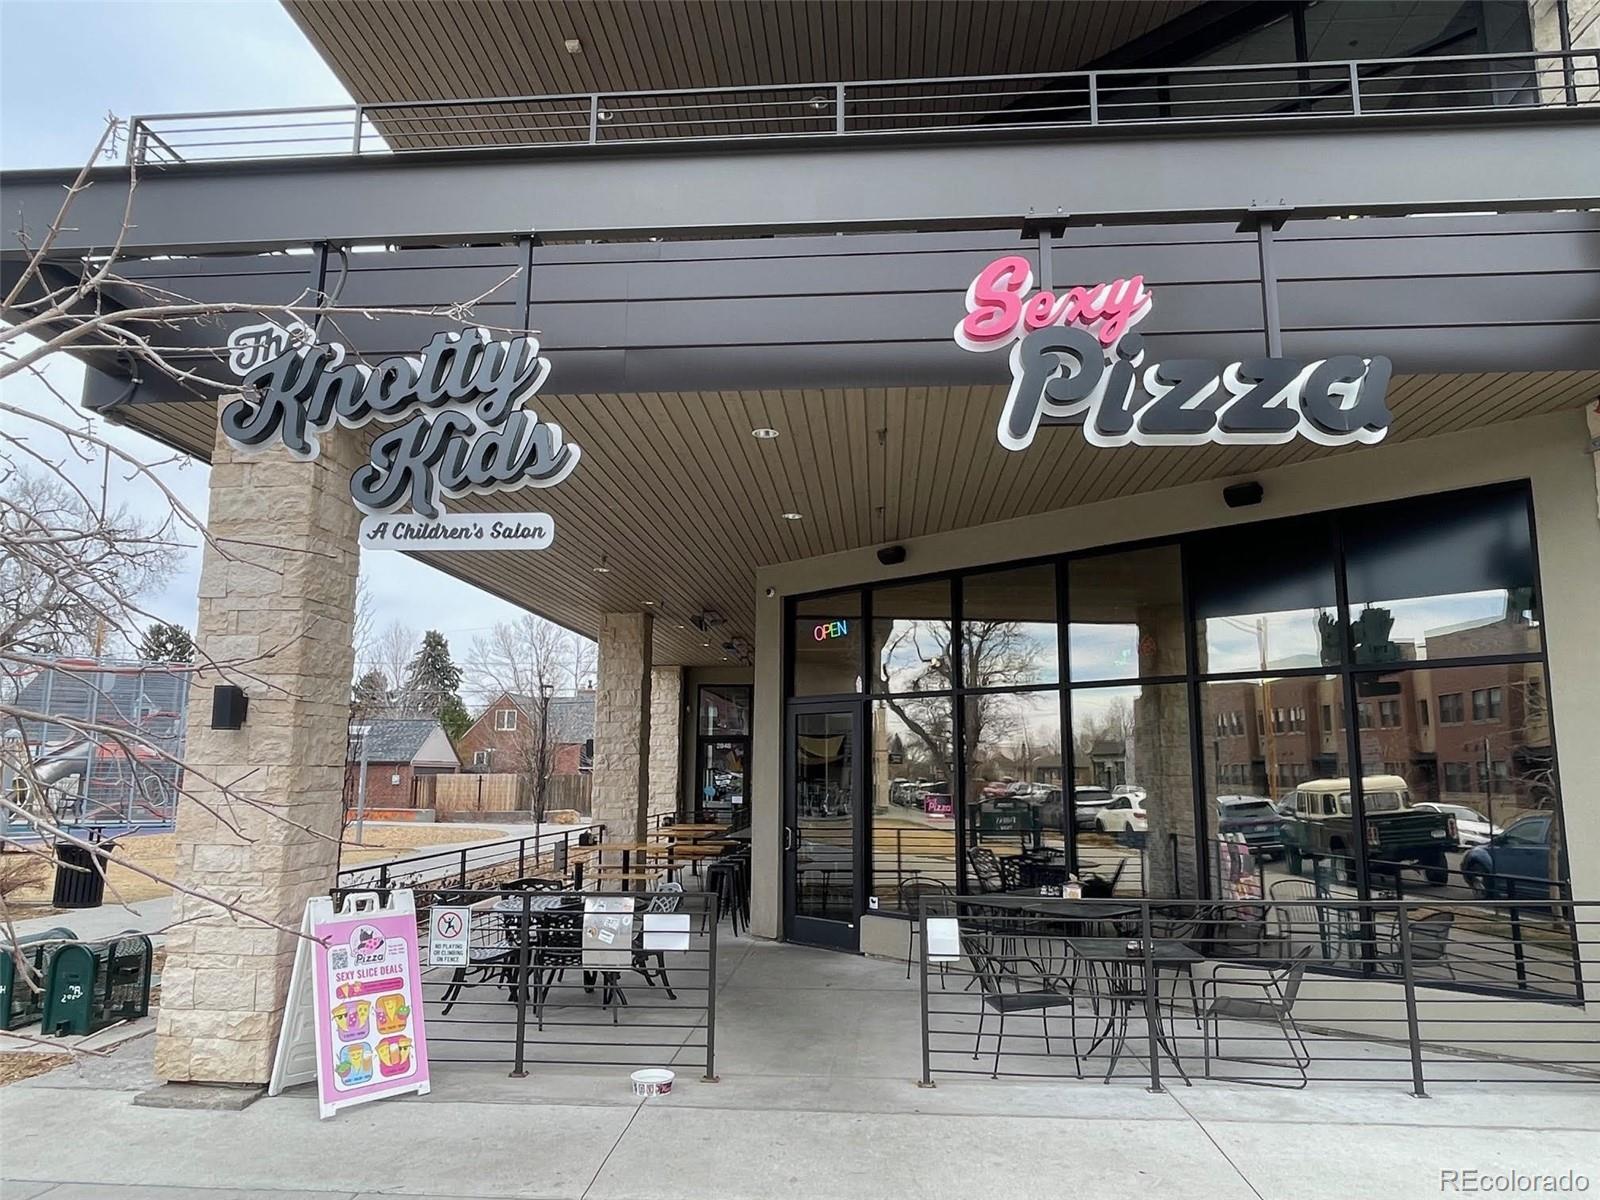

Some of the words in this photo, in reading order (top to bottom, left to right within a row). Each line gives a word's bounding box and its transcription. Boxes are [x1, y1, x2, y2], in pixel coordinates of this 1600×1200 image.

[960, 255, 1153, 349] Sexy
[233, 325, 307, 371] The
[221, 327, 546, 457] Knotty
[1000, 326, 1393, 447] Pizza
[350, 410, 573, 520] Kids
[366, 522, 389, 540] A
[392, 522, 484, 540] Children's
[490, 521, 547, 540] Salon
[814, 619, 848, 641] OPEN
[335, 970, 355, 982] SEXY
[356, 967, 378, 979] SLICE
[380, 963, 404, 976] DEALS
[356, 953, 384, 963] Pizza
